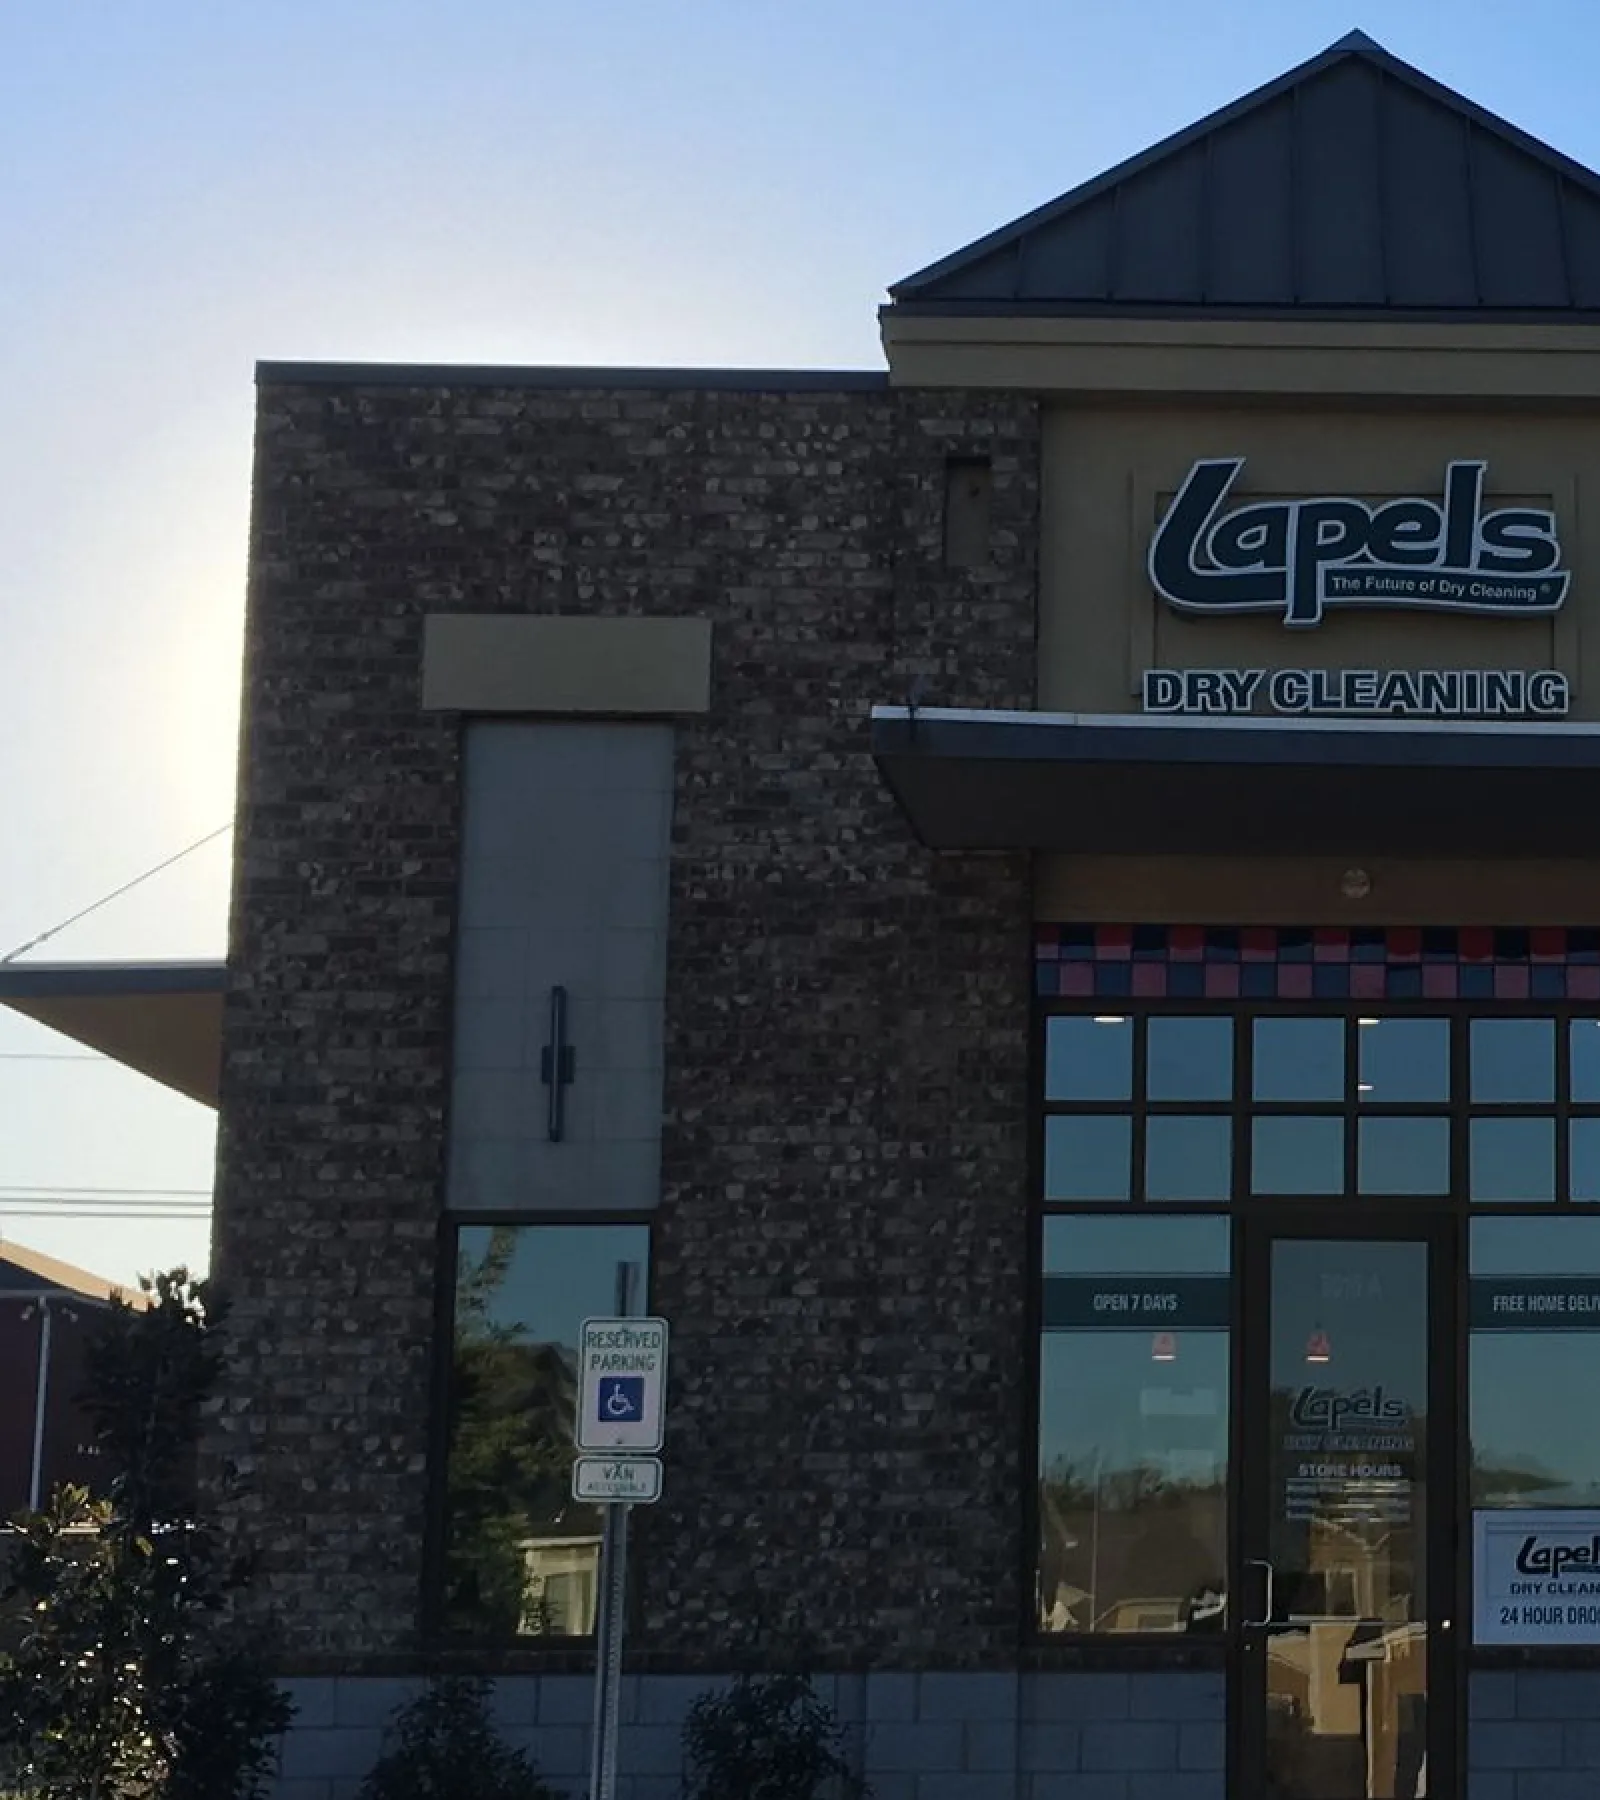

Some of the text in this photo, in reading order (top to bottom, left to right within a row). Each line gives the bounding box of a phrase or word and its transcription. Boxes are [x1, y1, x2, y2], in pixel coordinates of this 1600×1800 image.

[1148, 457, 1568, 625] Lapels
[1332, 576, 1361, 591] The
[1366, 576, 1415, 592] Future
[1419, 579, 1435, 593] of
[1439, 580, 1465, 597] Dry
[1143, 670, 1569, 714] DRY CLEANING
[1093, 1293, 1179, 1312] OPEN 7 DAYS
[1492, 1295, 1525, 1312] FREE
[1527, 1295, 1565, 1312] HOME
[588, 1331, 661, 1349] RESERVED
[590, 1353, 657, 1371] PARKING
[1290, 1385, 1406, 1432] Lapels
[1298, 1463, 1402, 1477] STORE HOURS
[1509, 1581, 1543, 1595] DRY
[1500, 1605, 1519, 1625] 24
[1523, 1605, 1563, 1625] HOUR
